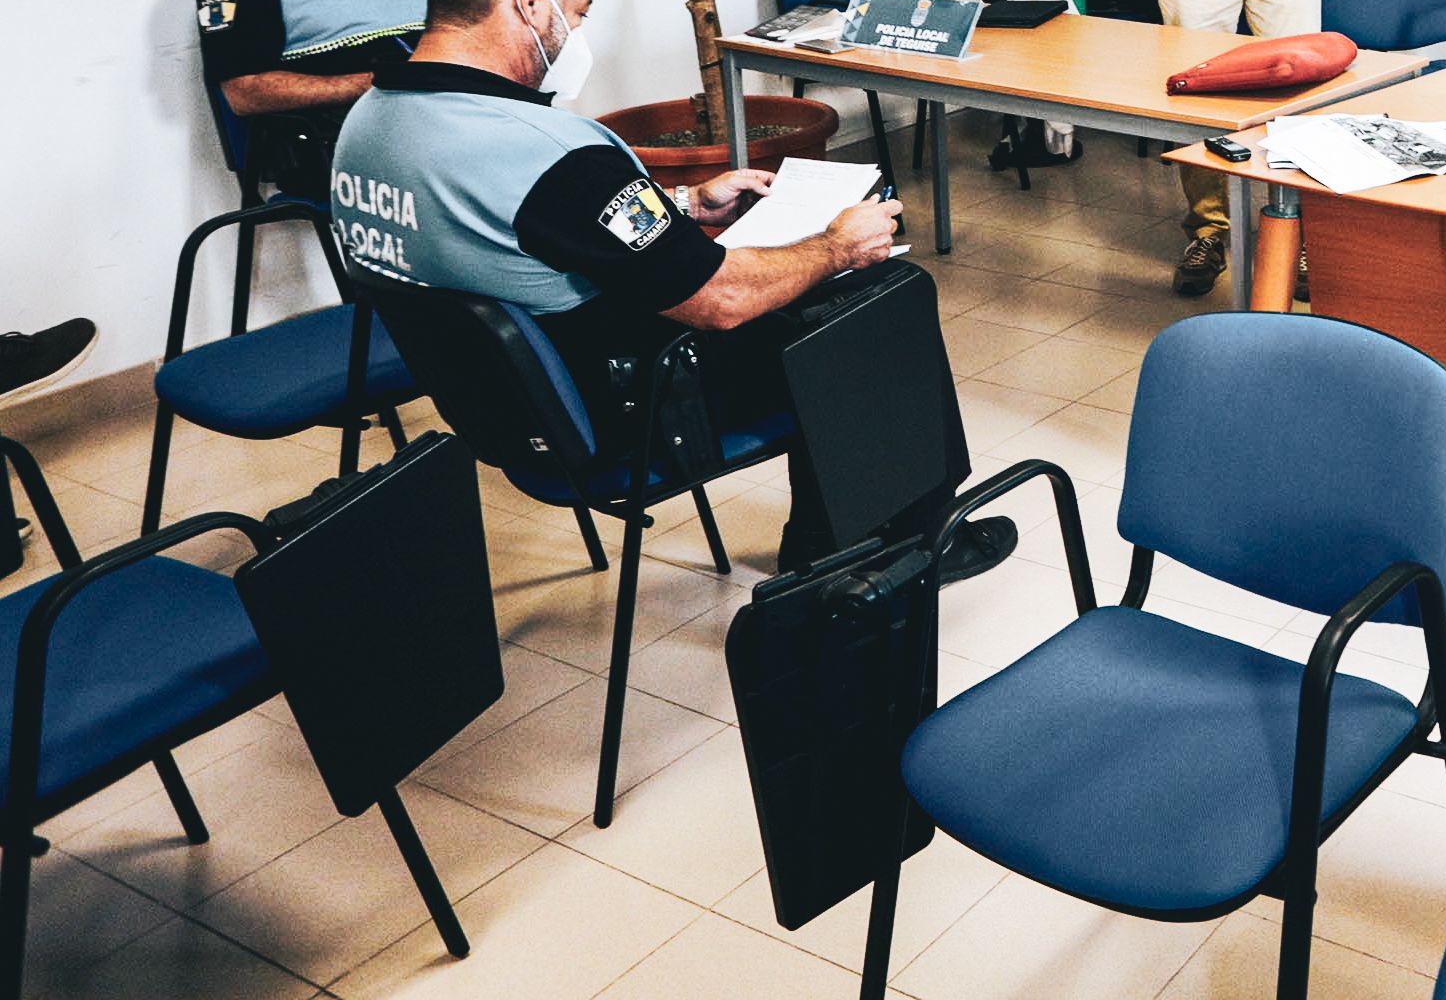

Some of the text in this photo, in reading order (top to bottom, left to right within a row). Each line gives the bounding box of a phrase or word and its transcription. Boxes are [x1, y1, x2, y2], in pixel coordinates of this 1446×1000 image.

[875, 23, 950, 43] POLICIA LOCAL
[879, 35, 939, 53] DE TEGUISE
[605, 182, 644, 217] POLICIA
[337, 218, 413, 272] LOCAL
